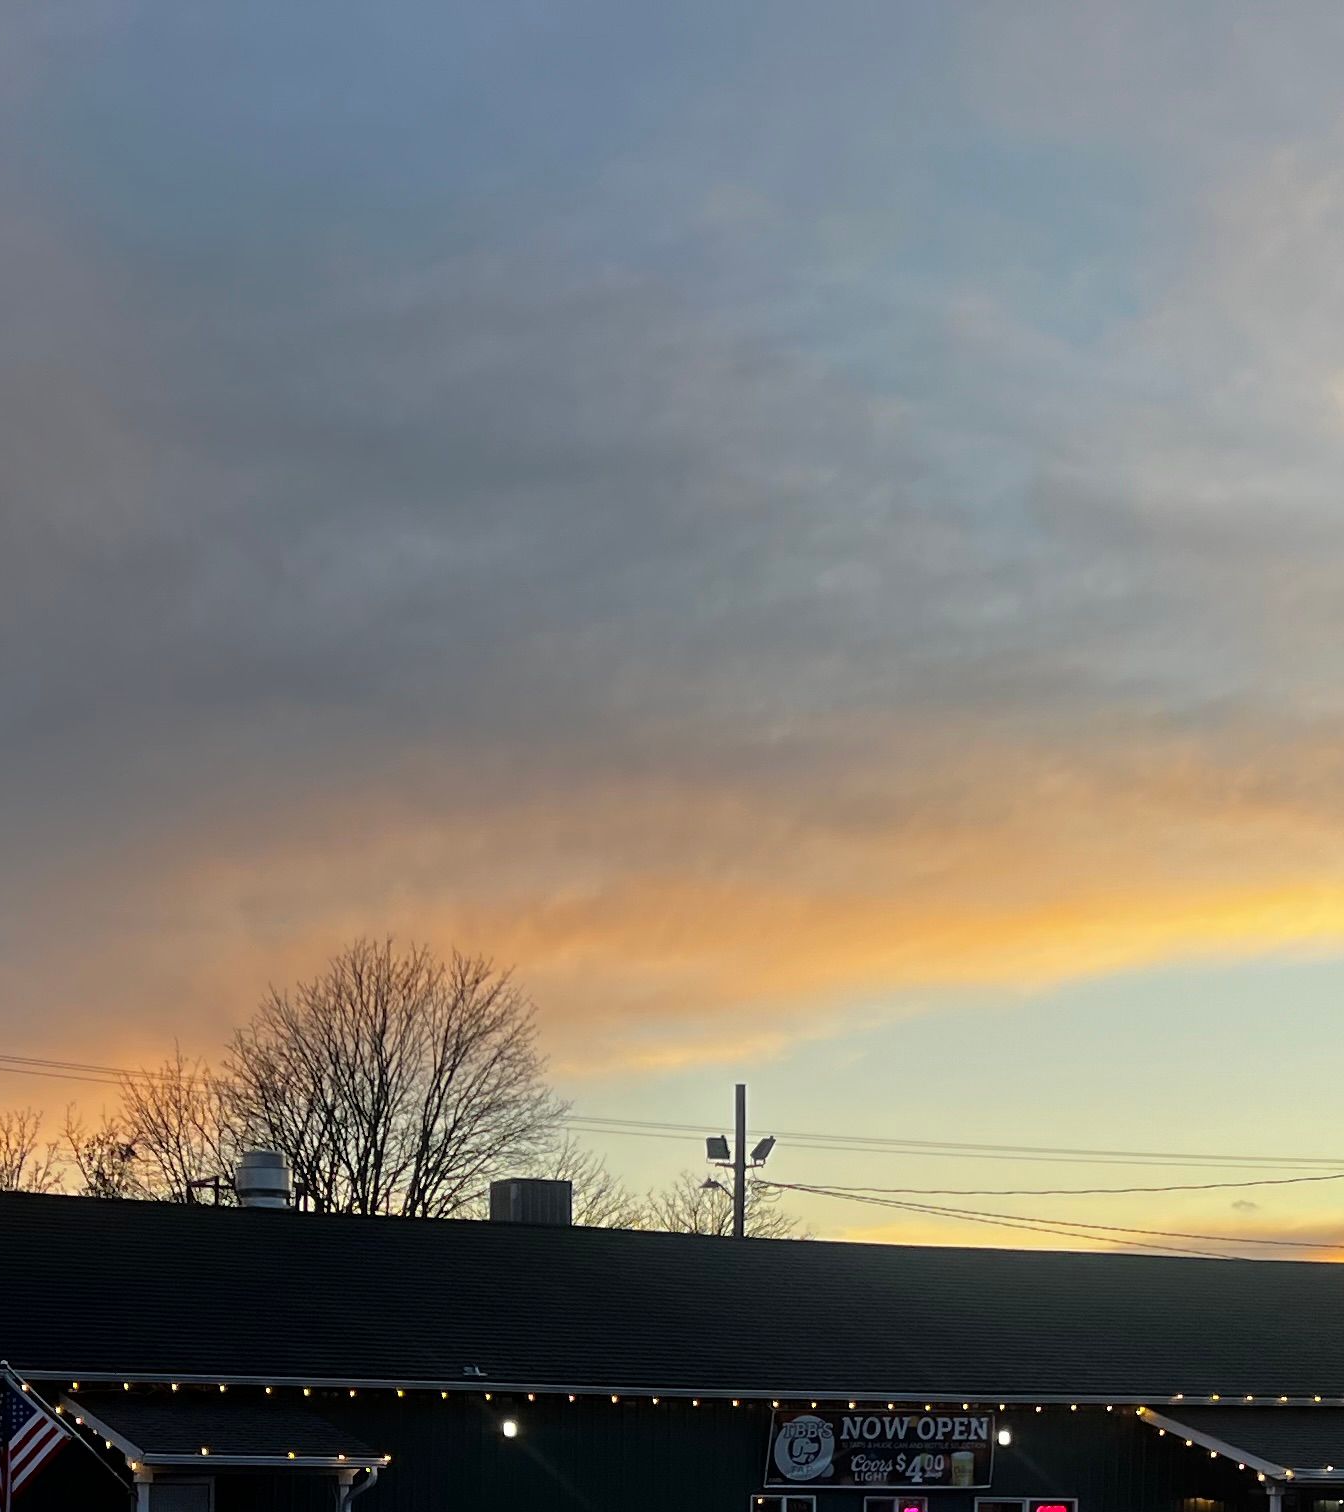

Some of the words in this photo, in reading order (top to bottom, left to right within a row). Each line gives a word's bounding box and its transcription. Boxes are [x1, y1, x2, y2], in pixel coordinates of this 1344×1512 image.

[782, 1421, 834, 1439] TBB'S
[840, 1416, 911, 1440] NOW
[916, 1416, 990, 1440] OPEN
[893, 1441, 908, 1449] CAN
[909, 1441, 923, 1449] AND
[850, 1453, 893, 1471] Coors
[854, 1472, 889, 1481] LIGHT
